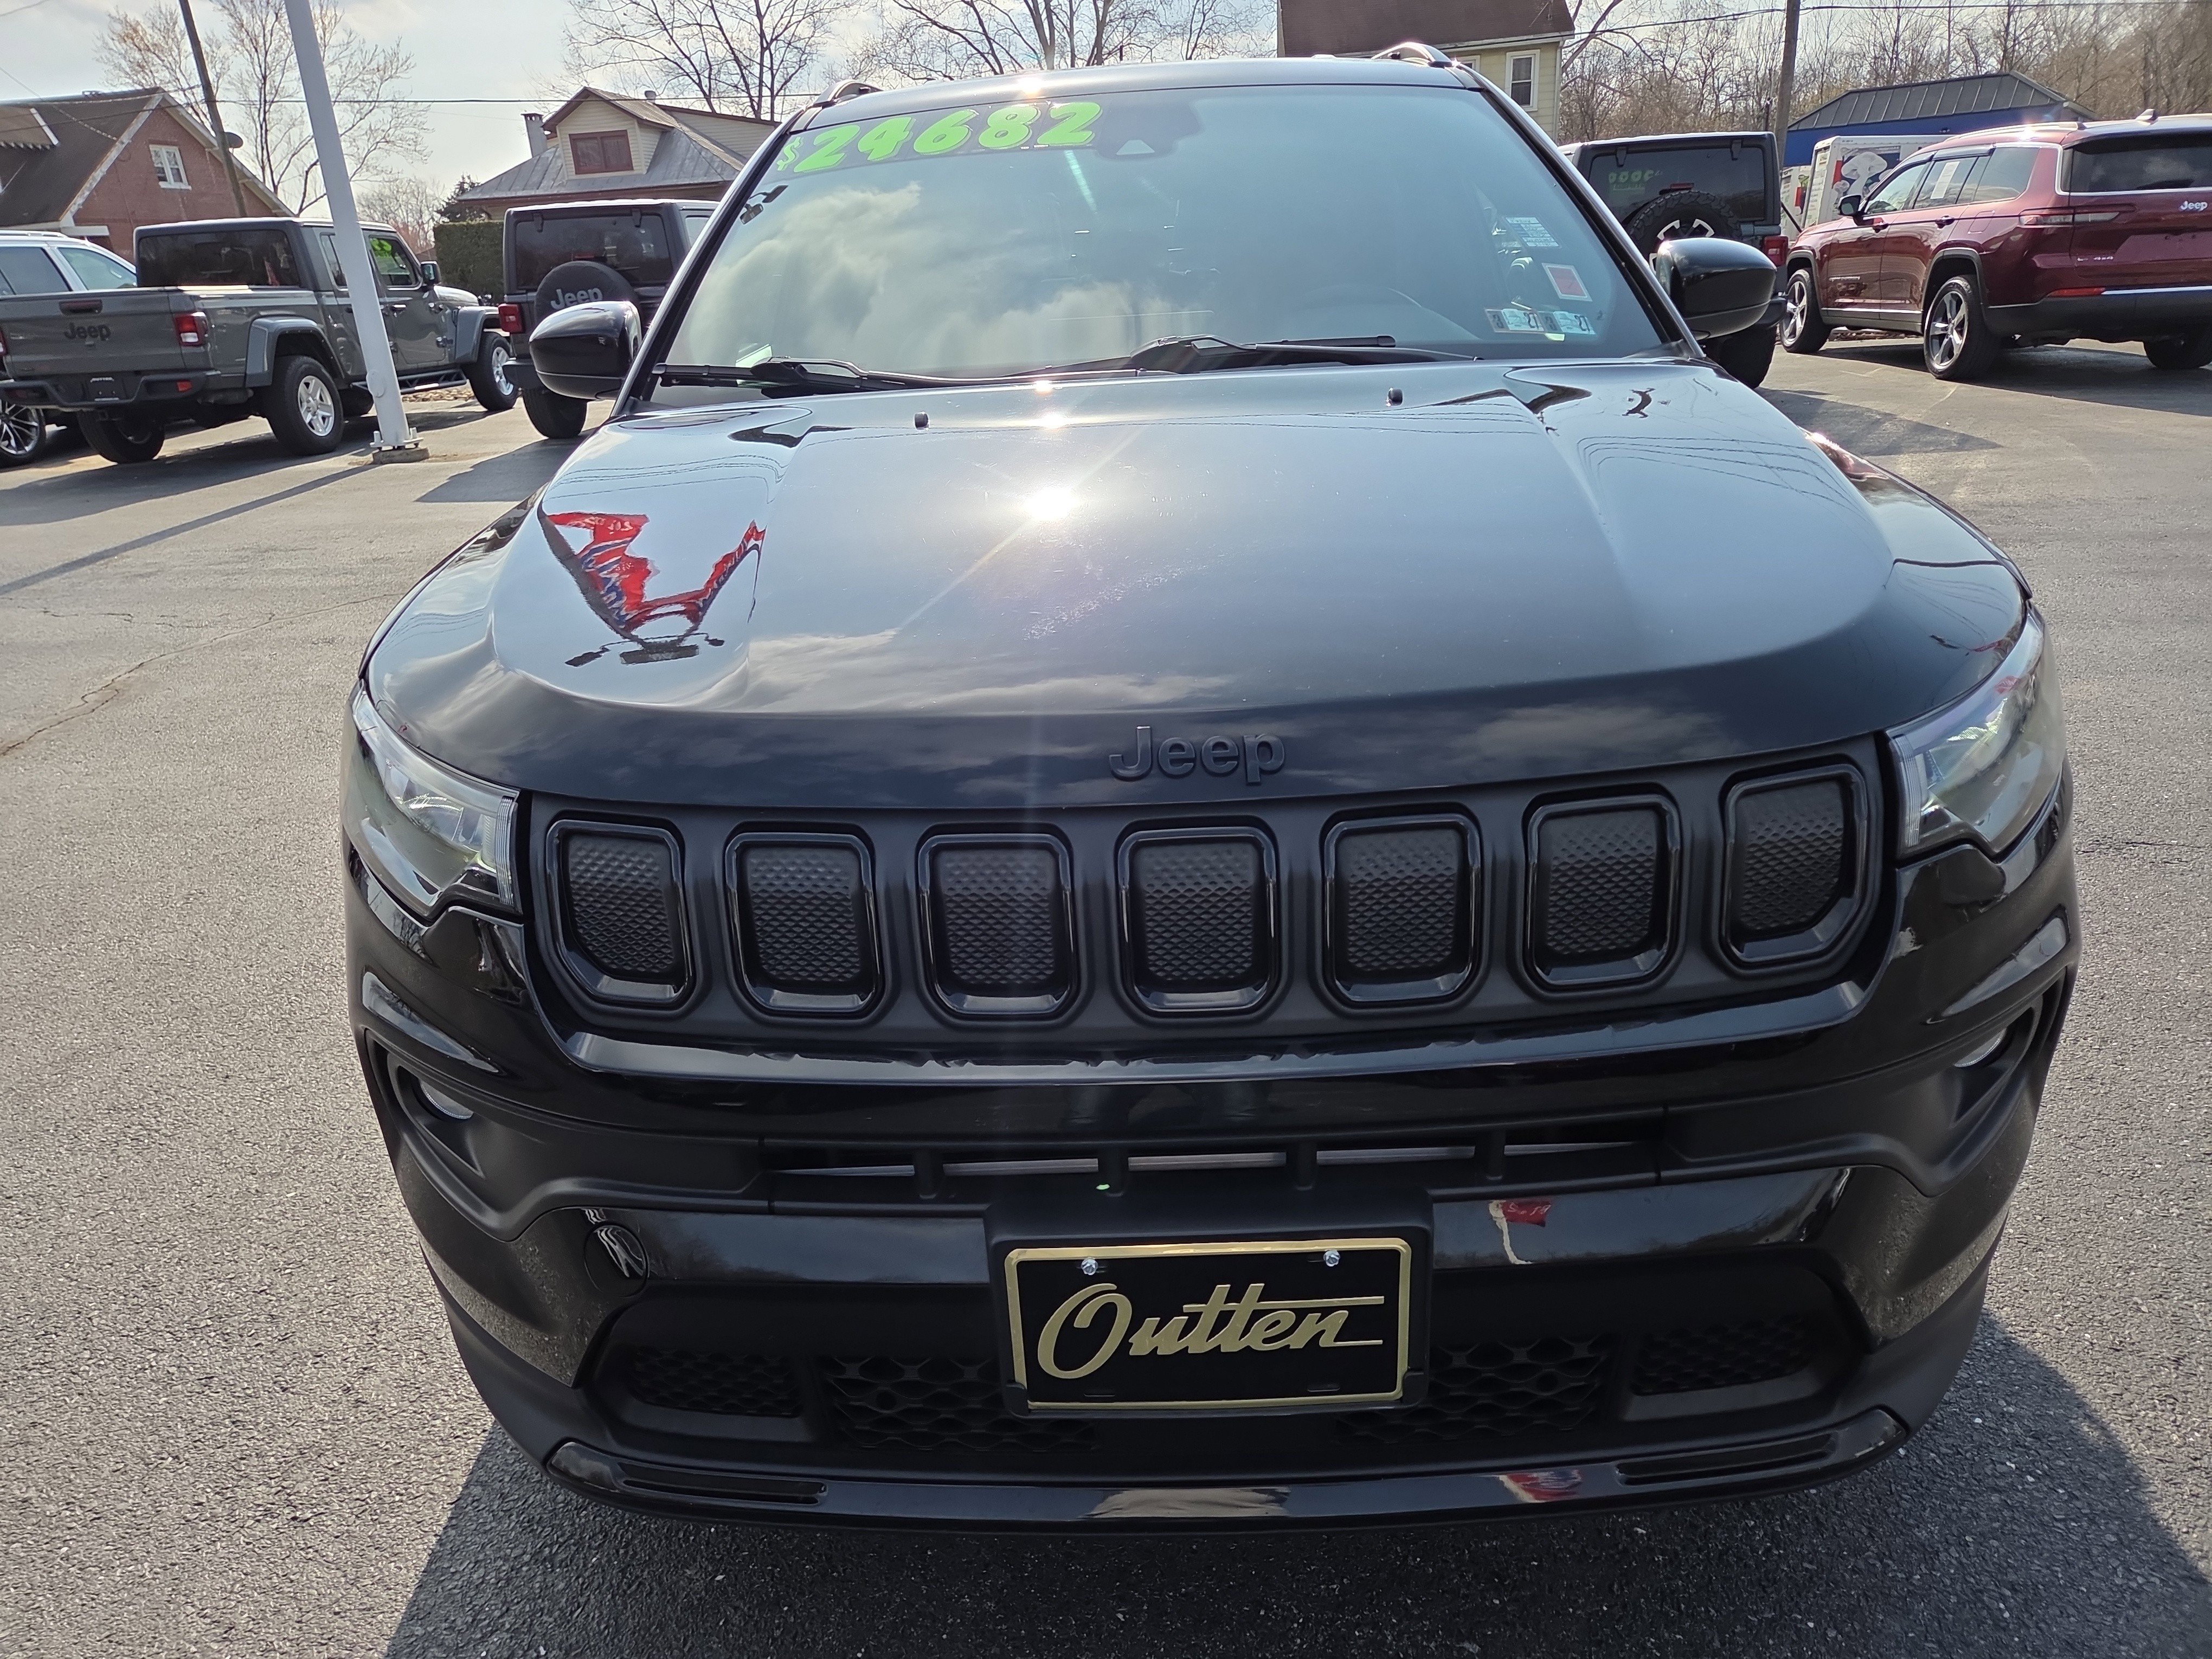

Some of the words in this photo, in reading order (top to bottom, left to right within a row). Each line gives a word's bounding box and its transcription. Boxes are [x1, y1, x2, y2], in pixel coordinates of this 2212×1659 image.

[776, 101, 1102, 173] $24682
[2179, 201, 2208, 211] Jeep
[550, 288, 603, 310] Jeep
[64, 322, 111, 342] Jeep
[1109, 725, 1286, 786] Jeep
[1037, 1283, 1385, 1379] Outten
